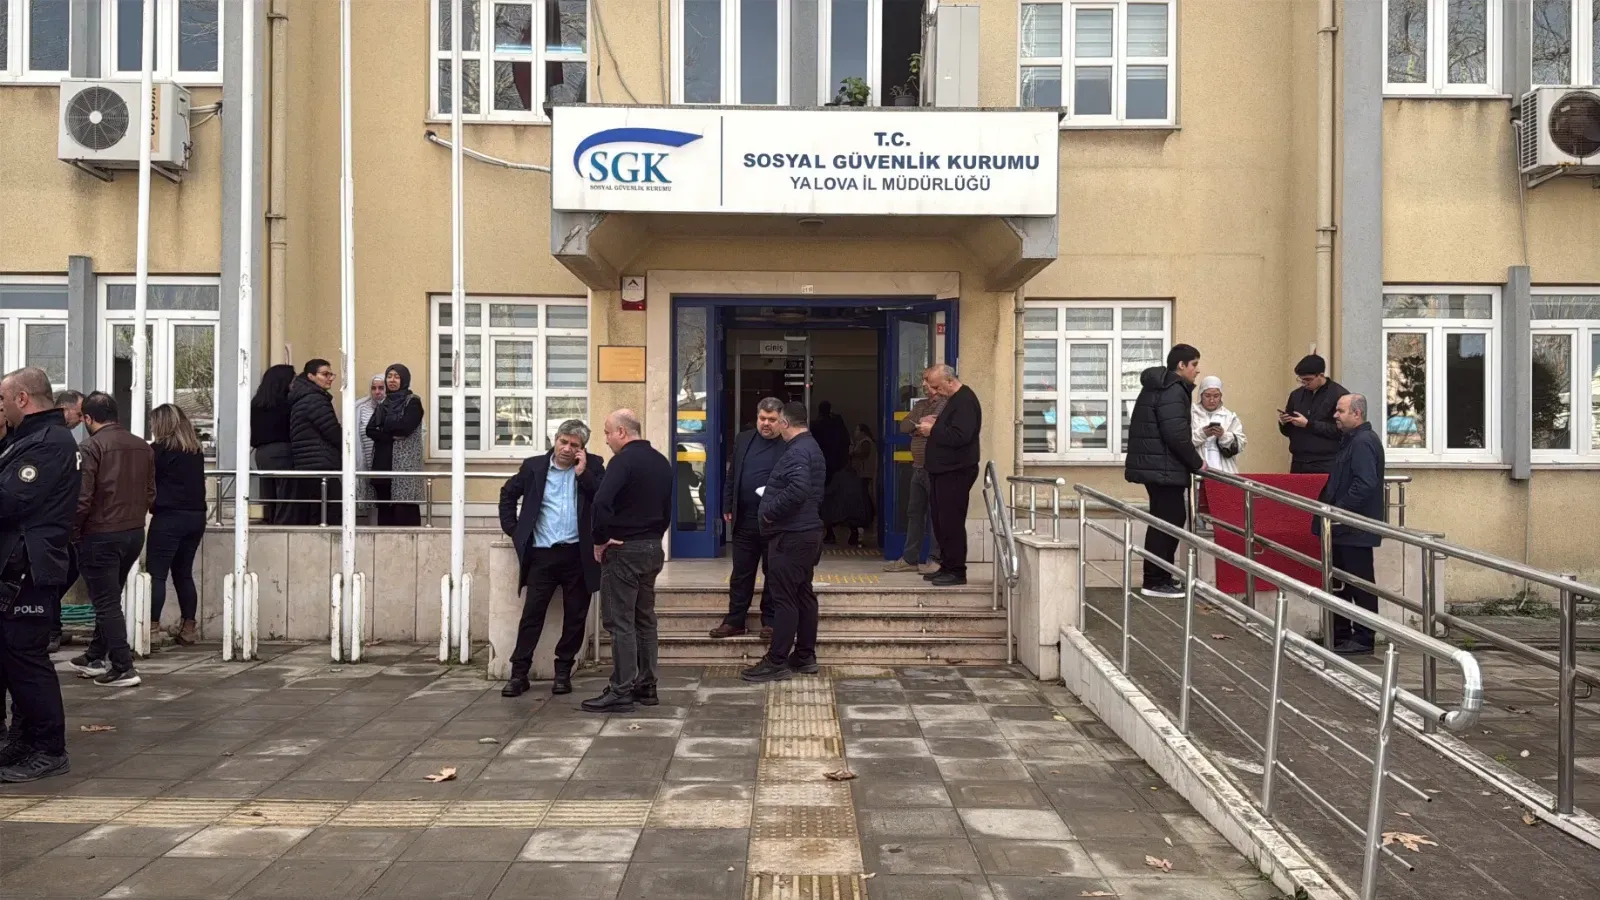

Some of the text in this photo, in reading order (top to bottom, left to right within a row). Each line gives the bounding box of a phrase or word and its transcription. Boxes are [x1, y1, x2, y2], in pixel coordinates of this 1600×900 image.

[874, 131, 911, 147] T.C.
[589, 150, 672, 184] SGK
[743, 151, 1040, 170] SOSYAL GÜVENLİK KURUMU
[790, 174, 991, 191] YALOVA İL MÜDÜRLÜĞÜ
